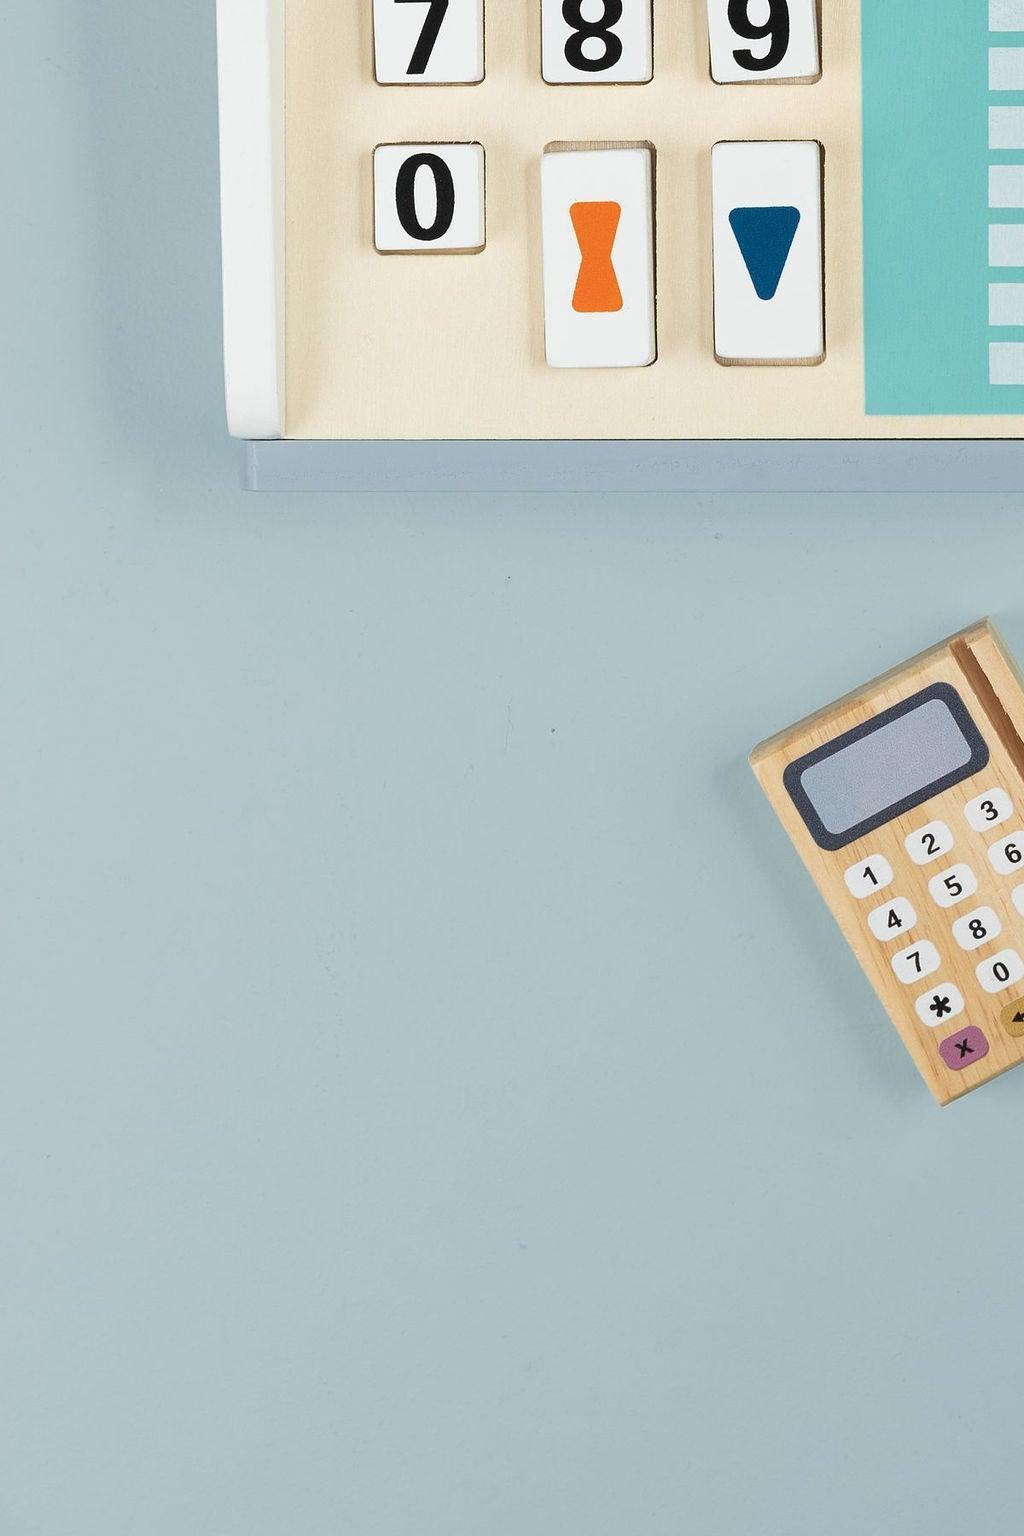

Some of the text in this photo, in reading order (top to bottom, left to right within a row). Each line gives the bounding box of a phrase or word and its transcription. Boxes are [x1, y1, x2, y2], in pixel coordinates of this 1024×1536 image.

[395, 153, 455, 241] 0
[863, 800, 999, 886] 1 2 3
[886, 843, 1022, 929] 4 5 6
[906, 951, 922, 973] 7
[968, 918, 987, 940] 8
[992, 961, 1010, 982] 0
